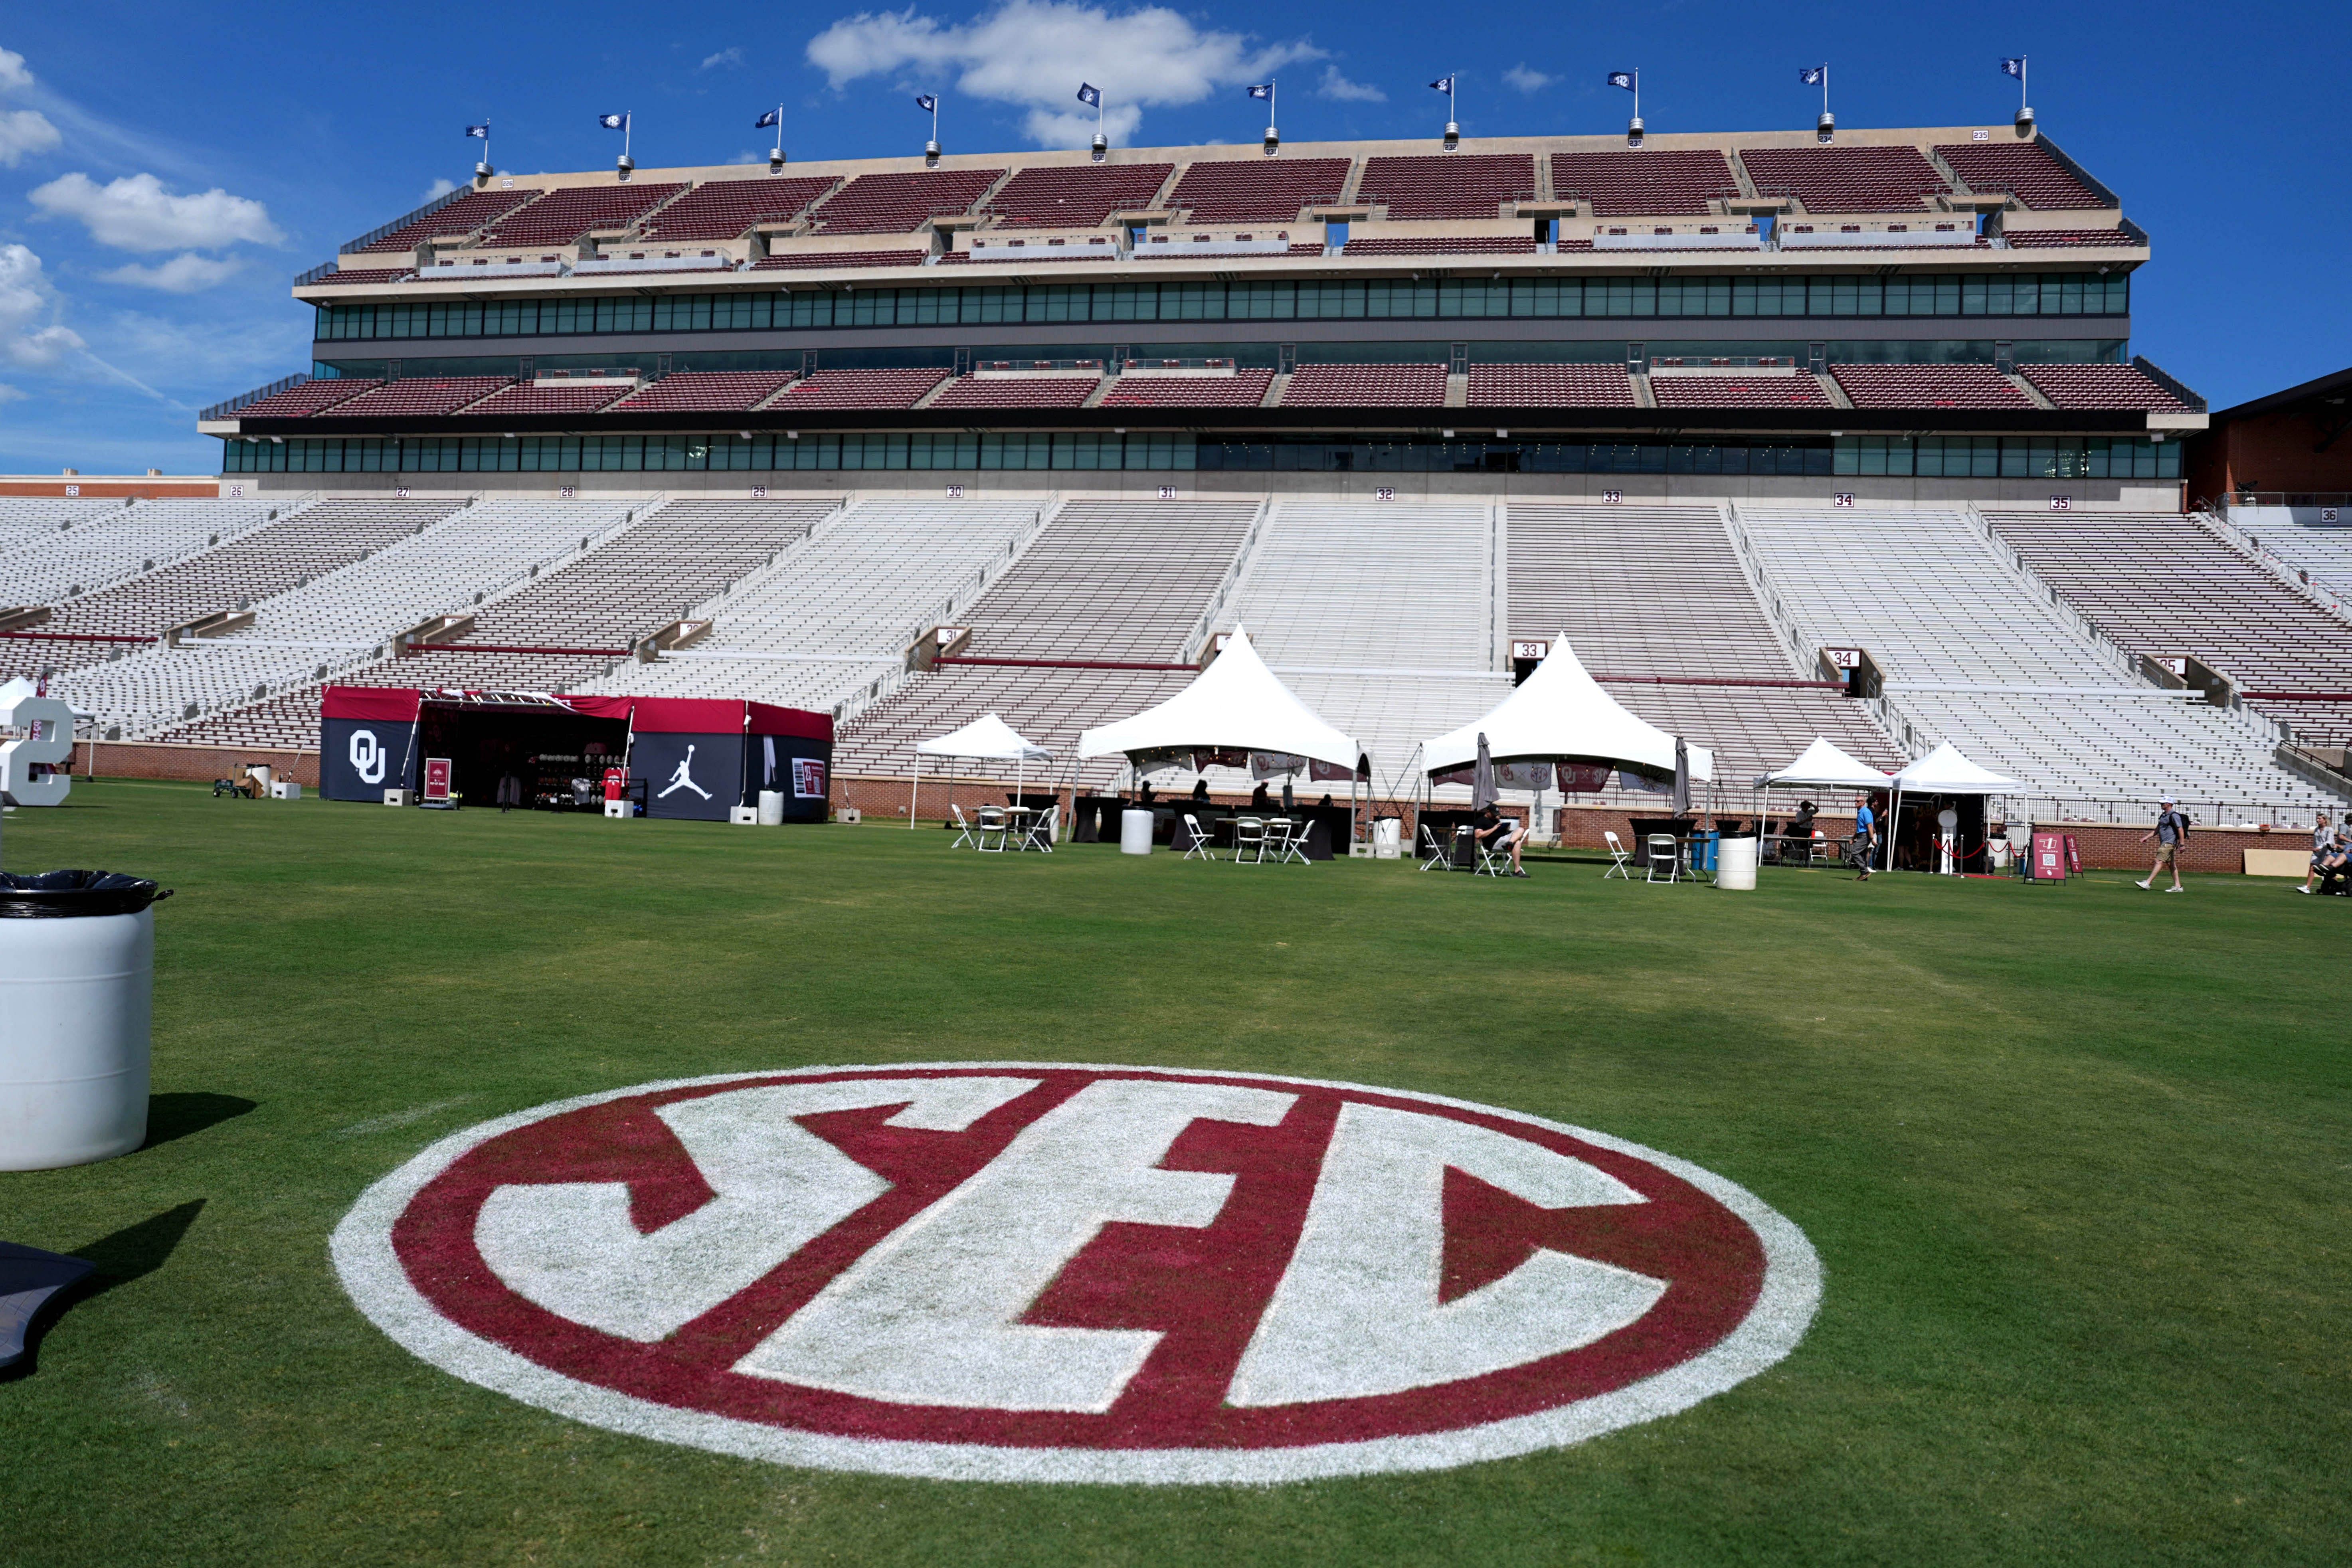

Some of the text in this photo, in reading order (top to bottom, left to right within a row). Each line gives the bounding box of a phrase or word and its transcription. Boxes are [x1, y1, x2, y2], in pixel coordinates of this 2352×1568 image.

[231, 487, 241, 495] 26
[398, 488, 408, 496] 27
[562, 487, 573, 496] 28
[754, 487, 765, 496] 29
[949, 486, 960, 496] 30
[1161, 488, 1172, 497] 31
[1379, 489, 1392, 499] 32
[1605, 492, 1619, 502] 33
[1837, 495, 1852, 505] 34
[2053, 497, 2068, 508] 35
[2323, 510, 2336, 520] 36
[1522, 644, 1536, 656] 33
[1834, 653, 1851, 665] 34
[350, 730, 386, 784] OU
[1531, 768, 1547, 782] SEC
[1561, 766, 1576, 784] OU
[1593, 769, 1609, 784] SEC
[473, 1077, 1668, 1415] SEC
